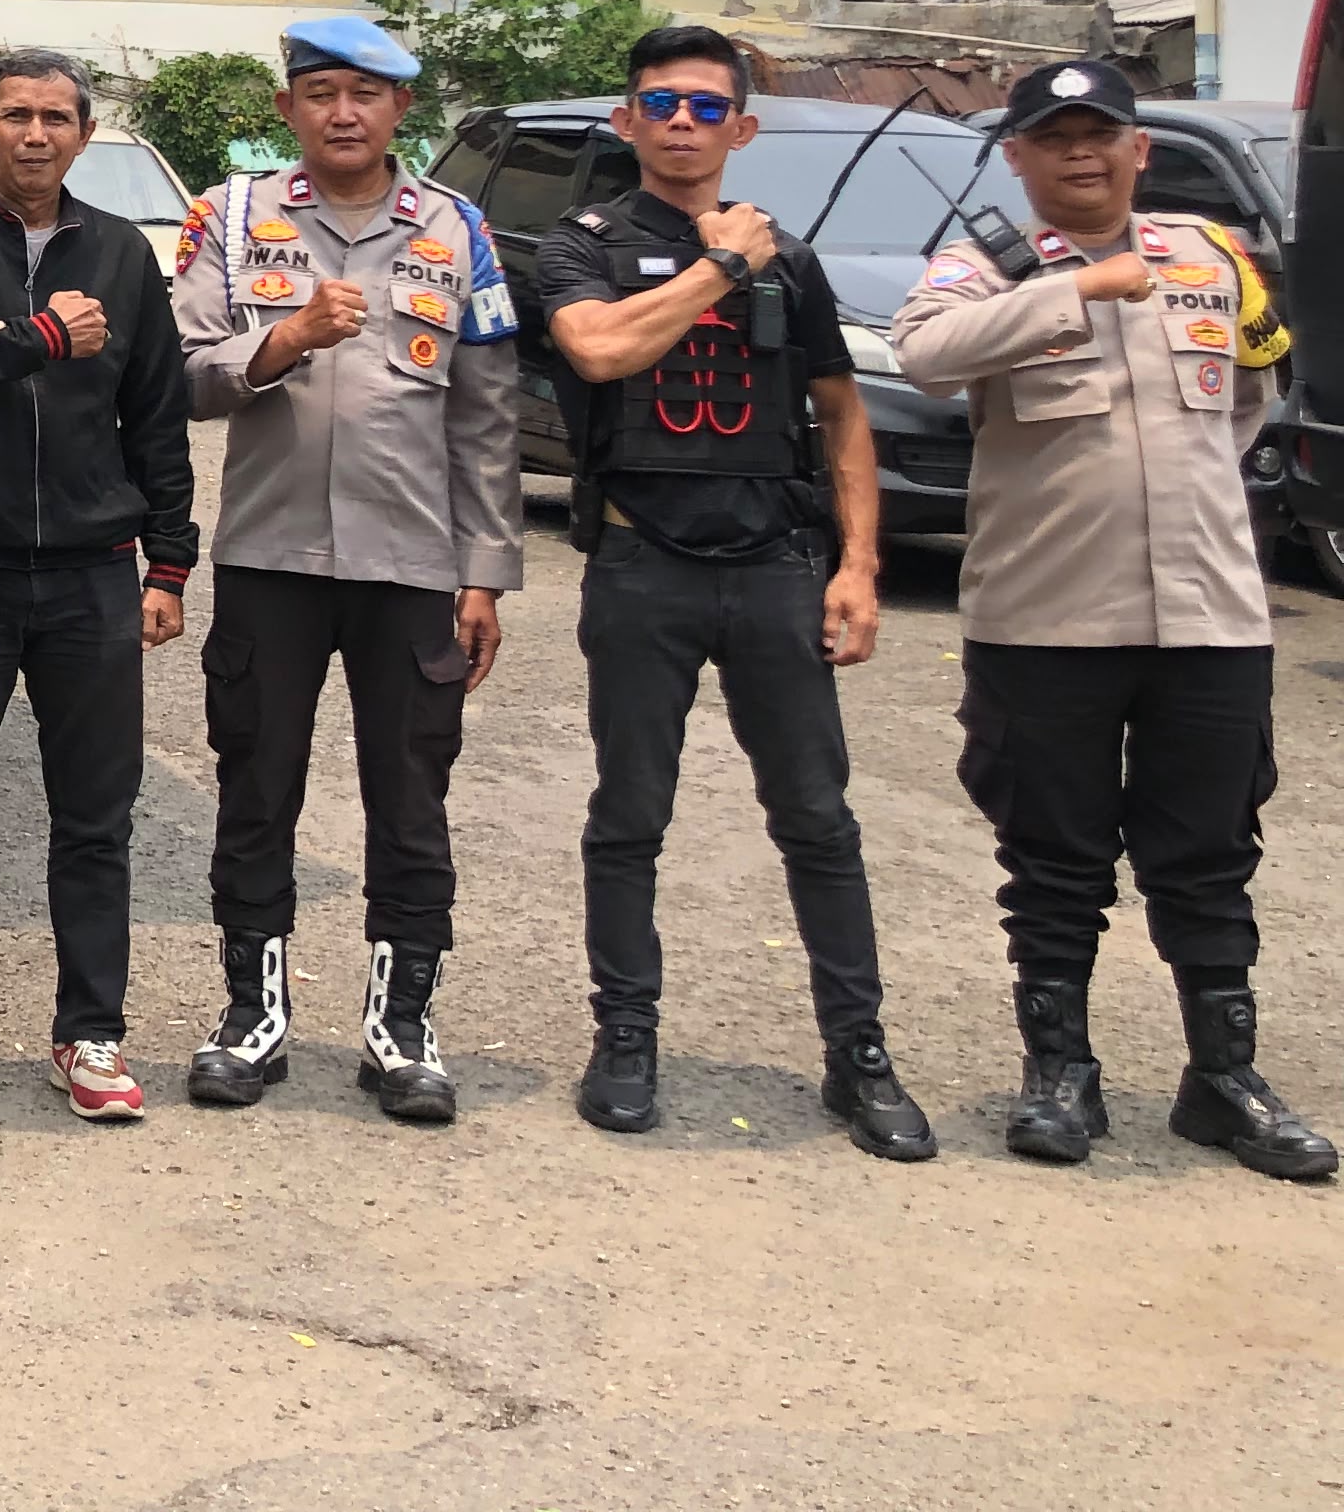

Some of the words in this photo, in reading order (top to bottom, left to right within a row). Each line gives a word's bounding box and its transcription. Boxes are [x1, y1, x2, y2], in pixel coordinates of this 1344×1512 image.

[244, 247, 309, 267] IWAN
[392, 261, 462, 291] POLRI
[1164, 293, 1230, 313] POLRI
